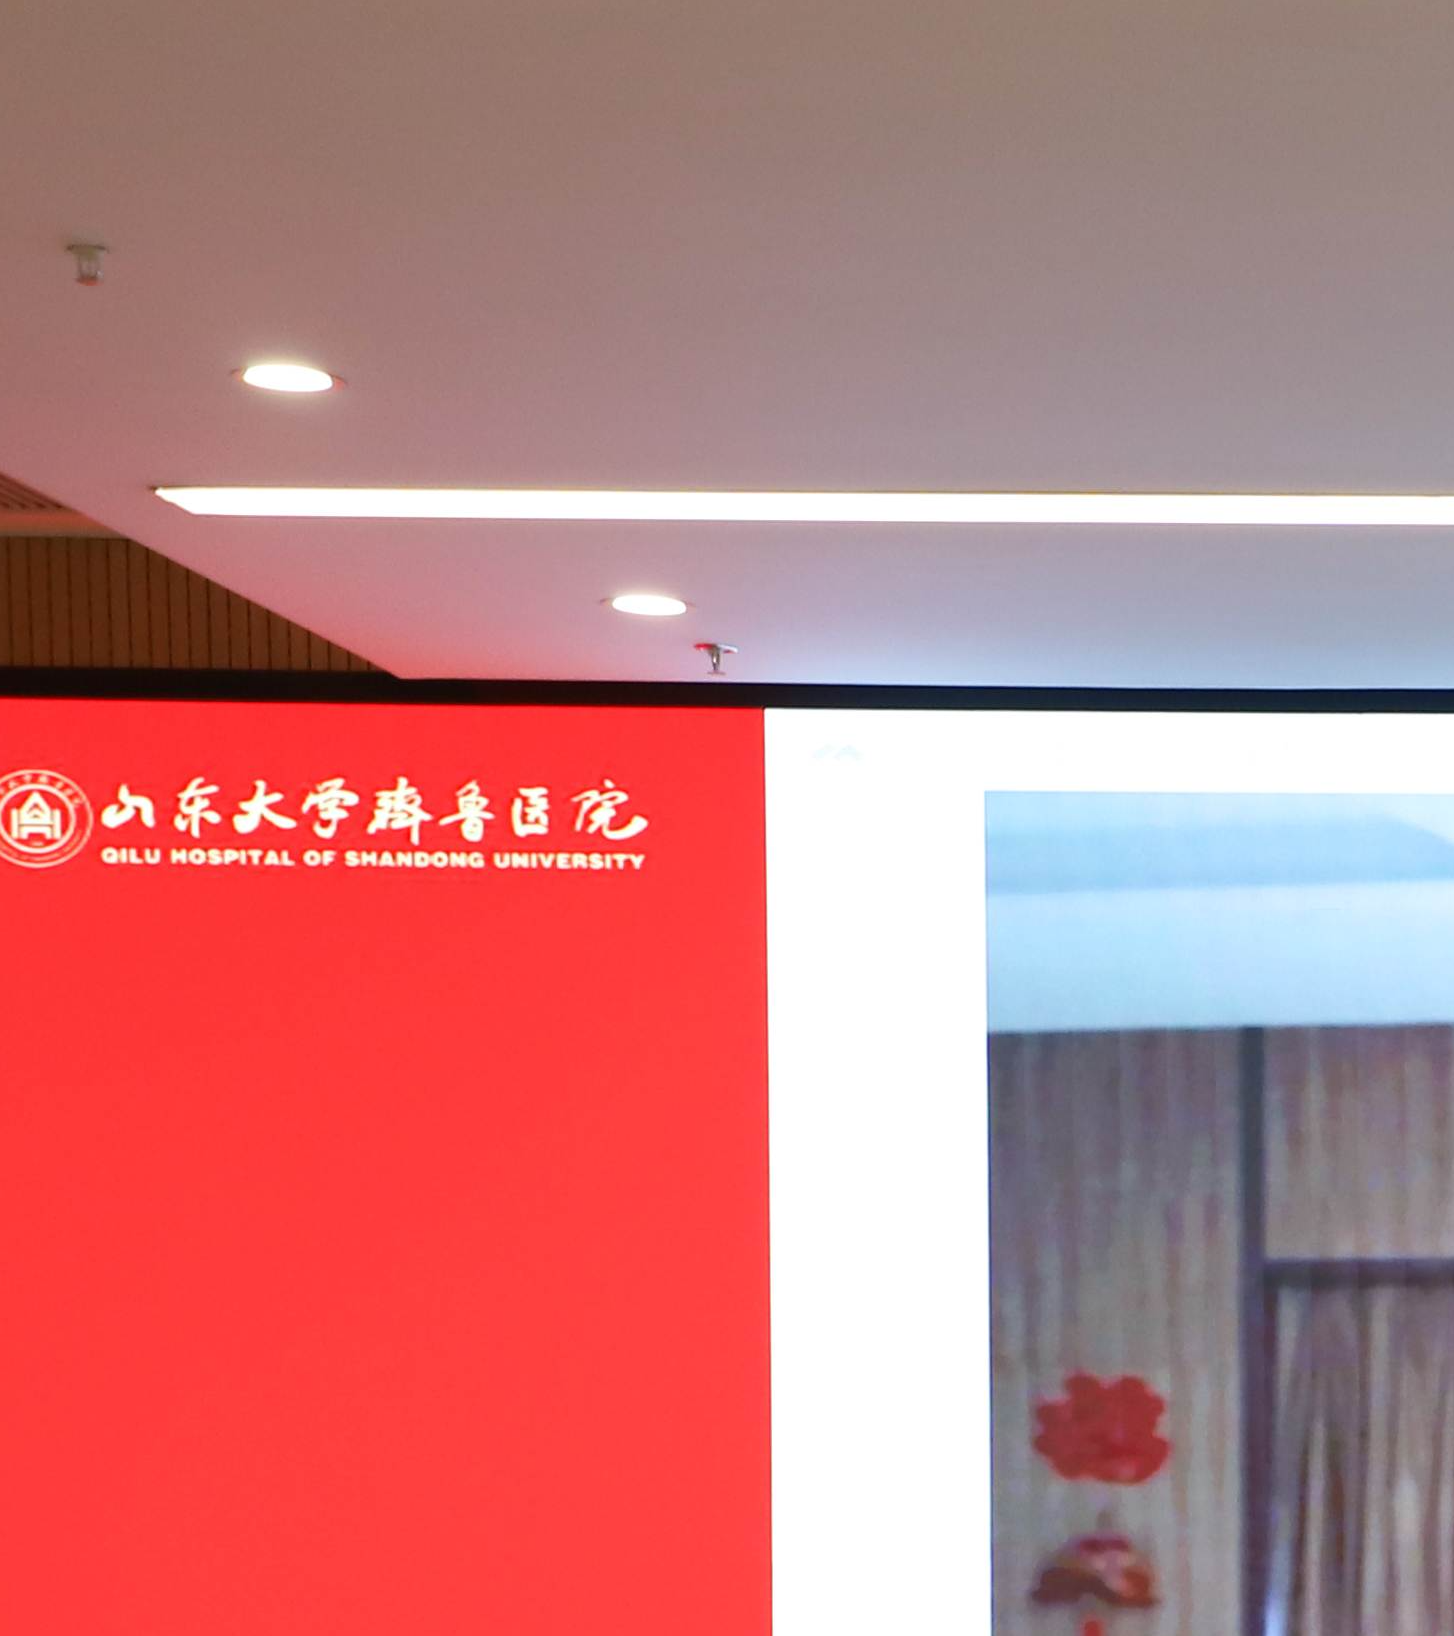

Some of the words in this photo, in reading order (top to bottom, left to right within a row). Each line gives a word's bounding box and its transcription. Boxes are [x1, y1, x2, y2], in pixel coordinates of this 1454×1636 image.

[101, 847, 161, 865] QILU
[170, 848, 295, 867] HOSPITAL
[303, 850, 336, 867] OF
[345, 850, 485, 869] SHANDONG
[493, 852, 645, 870] UNIVERSITY
